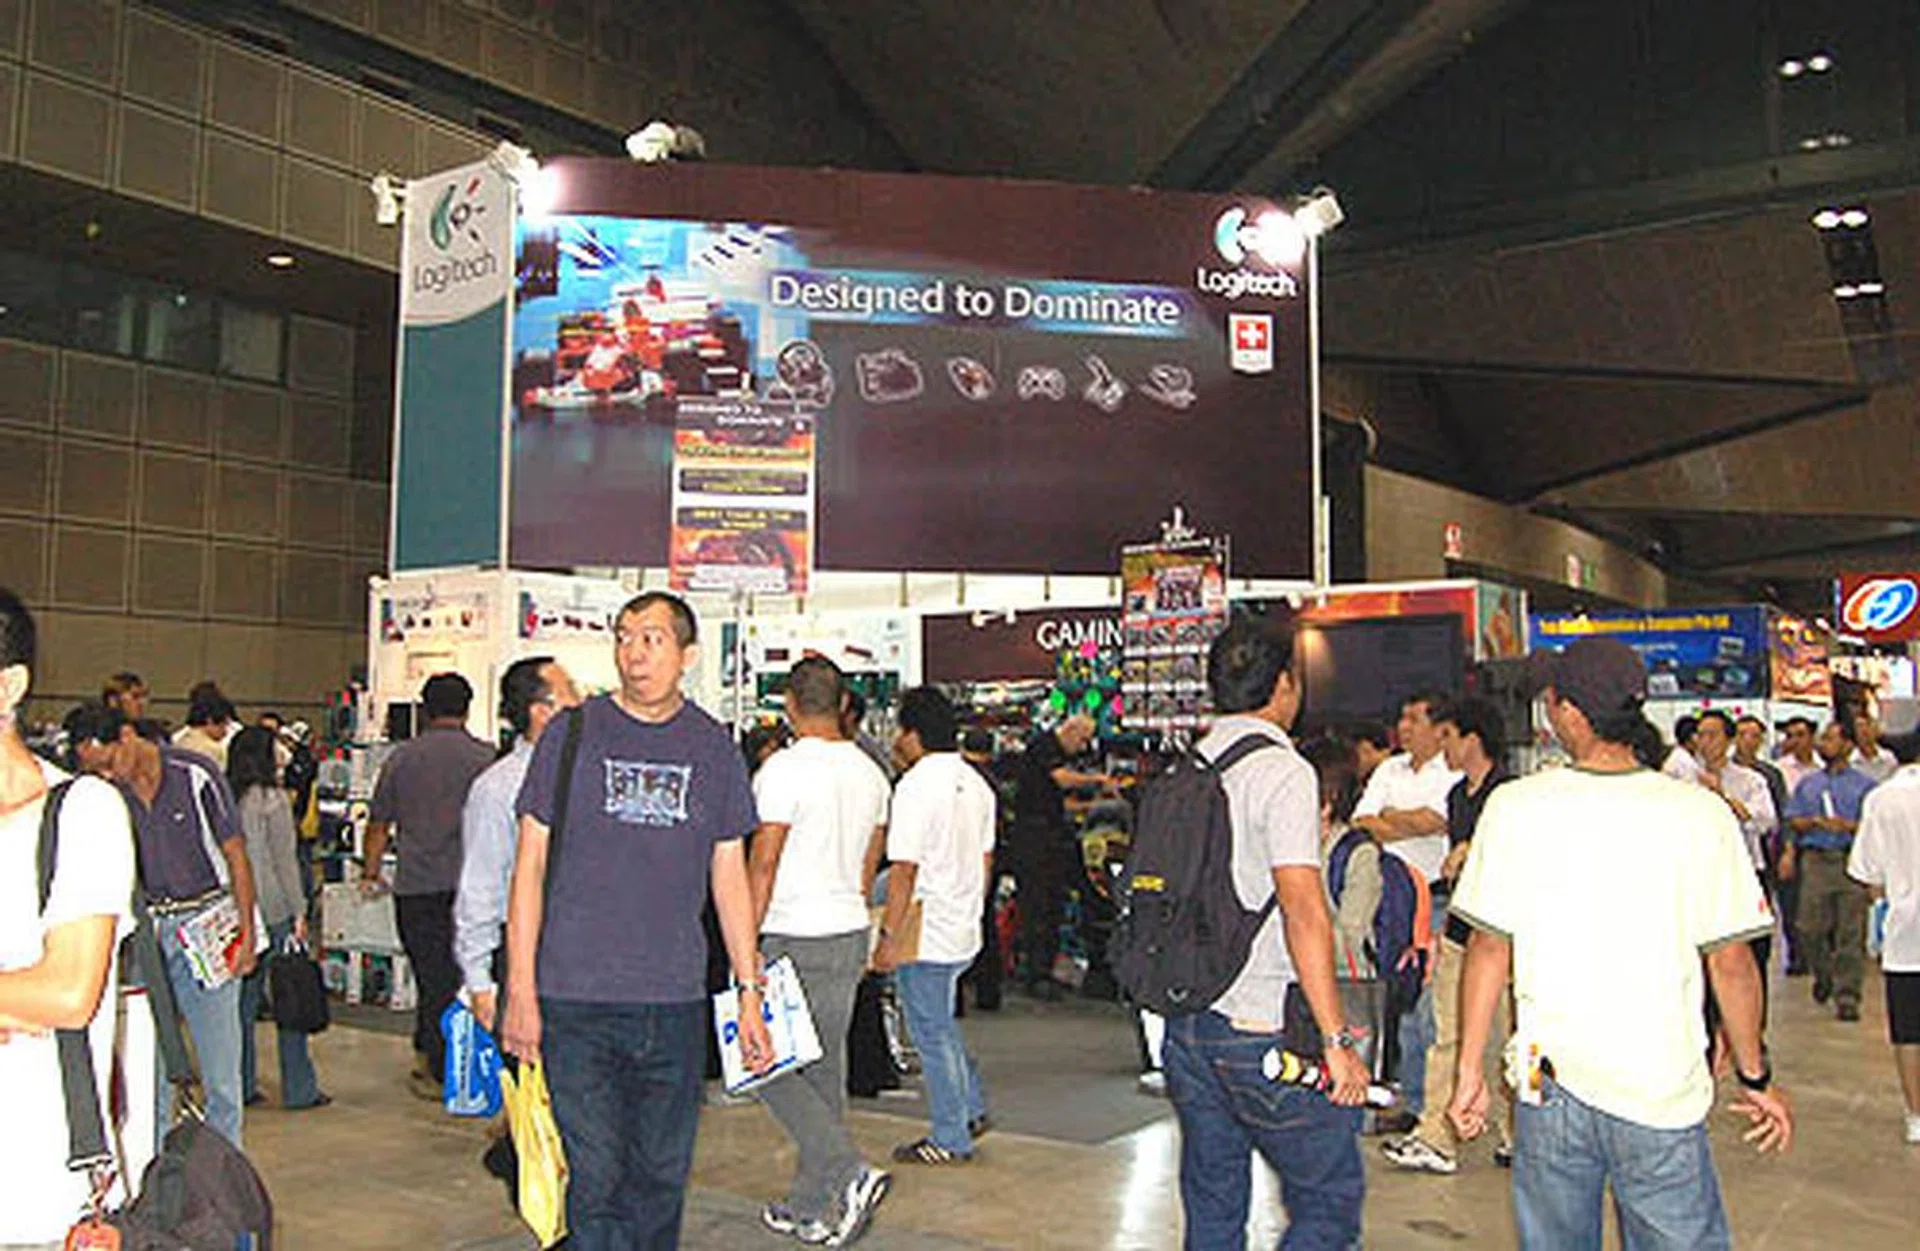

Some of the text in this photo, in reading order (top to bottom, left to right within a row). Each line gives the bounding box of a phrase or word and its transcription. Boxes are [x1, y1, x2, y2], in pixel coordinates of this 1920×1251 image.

[414, 246, 498, 294] Logitech
[1197, 266, 1297, 299] Logitech
[770, 274, 1181, 326] Designed to Dominate
[1036, 619, 1123, 651] GAMIN
